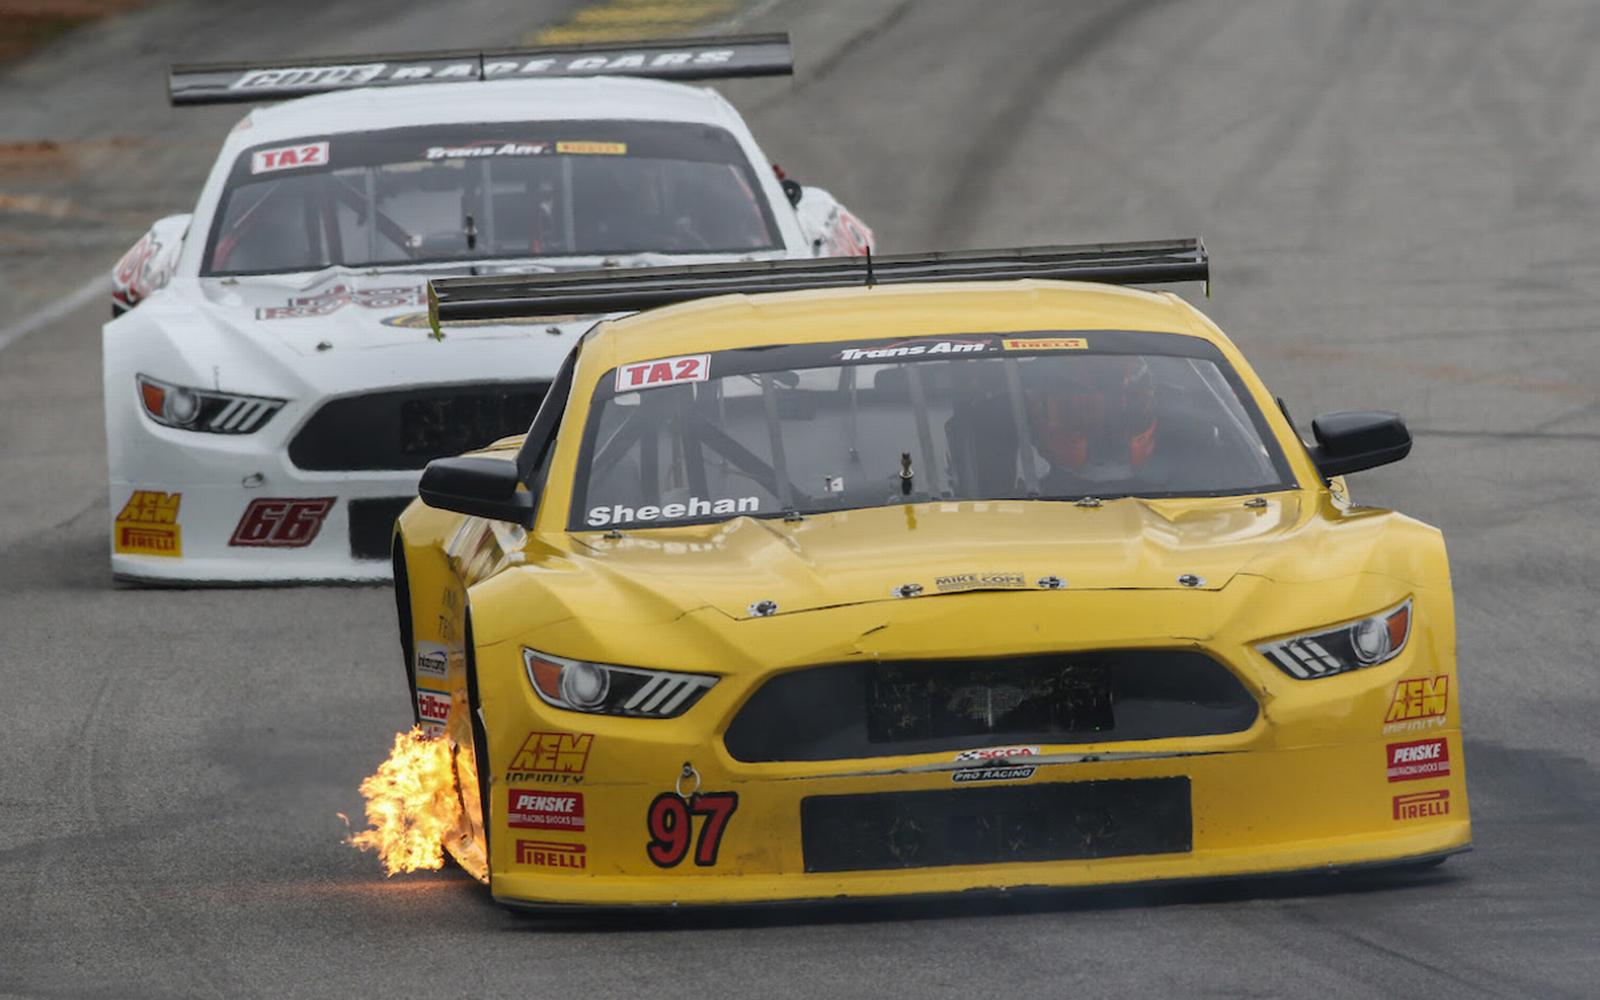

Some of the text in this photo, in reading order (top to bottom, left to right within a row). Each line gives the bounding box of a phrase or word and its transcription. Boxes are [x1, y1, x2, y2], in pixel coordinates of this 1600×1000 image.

[390, 58, 556, 79] RACE
[566, 50, 735, 70] CARS
[261, 146, 320, 168] TA2
[426, 143, 544, 159] Trans Am
[840, 341, 986, 361] Trans Am
[626, 359, 700, 386] TA2
[230, 497, 336, 548] 66
[587, 496, 760, 527] Sheehan
[122, 527, 176, 550] PIRELLI
[935, 574, 977, 585] MIKE
[1384, 675, 1449, 724] AEM
[1383, 717, 1447, 735] INFINITY
[508, 731, 595, 773] AEM
[978, 748, 1033, 760] SCCA
[1393, 743, 1441, 764] PENSKE
[505, 772, 585, 783] INFINITY
[954, 769, 1032, 781] PRO RACING
[516, 795, 577, 813] PENSKE
[1392, 789, 1450, 821] PIRELLI
[647, 791, 739, 869] 97
[516, 839, 586, 869] PIRELLI
